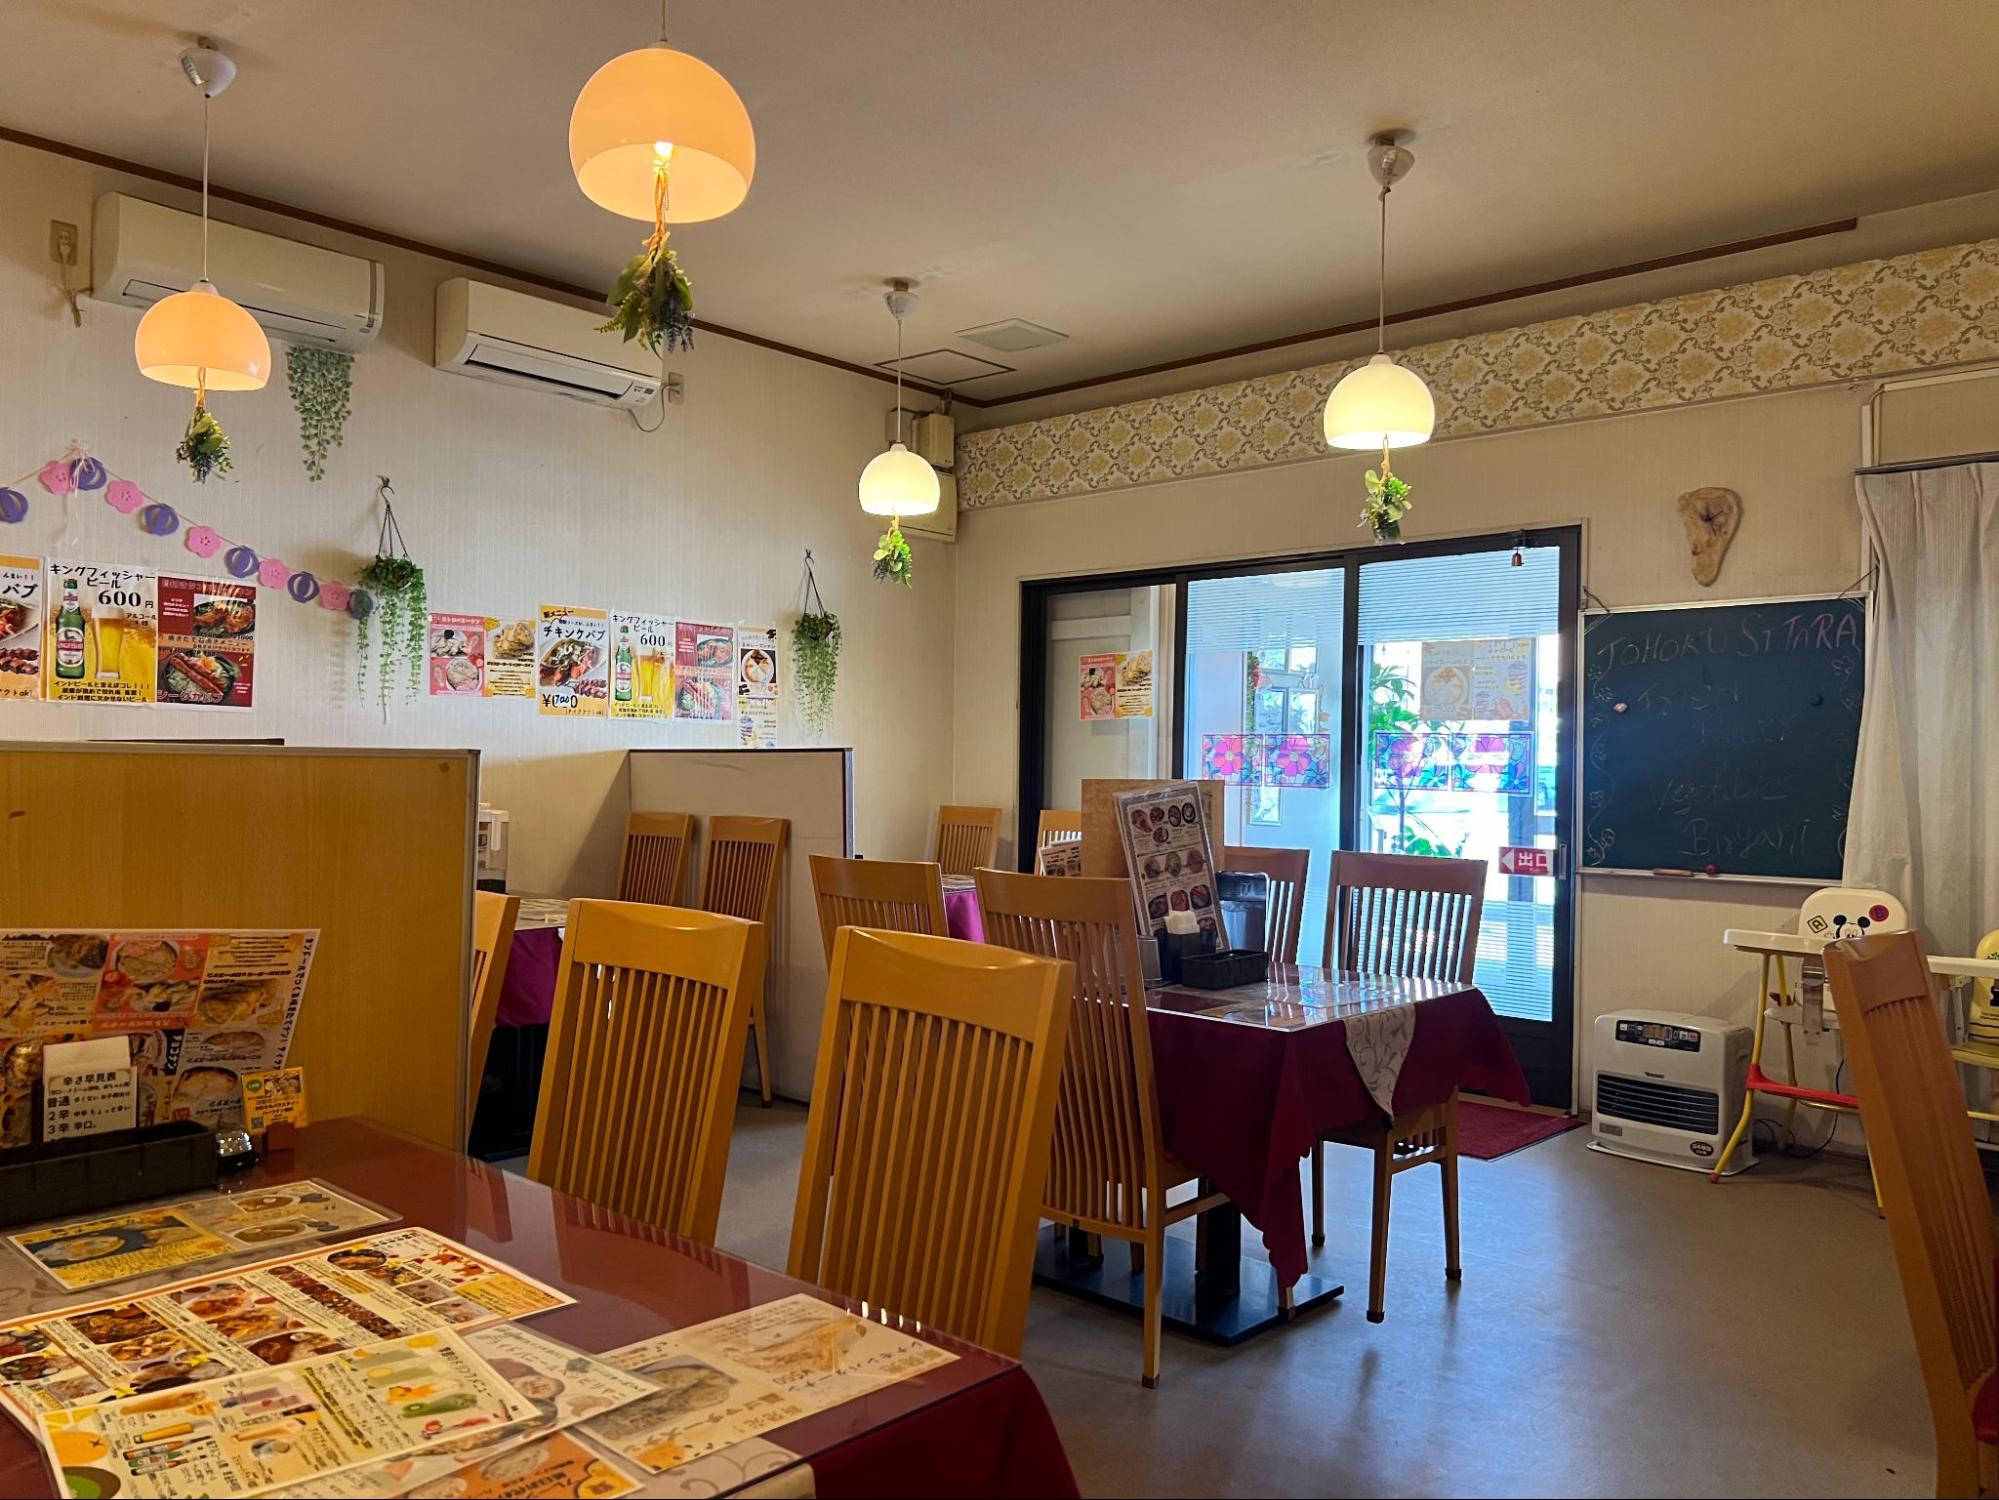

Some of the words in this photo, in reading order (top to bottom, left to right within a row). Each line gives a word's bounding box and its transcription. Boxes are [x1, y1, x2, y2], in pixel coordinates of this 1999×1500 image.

[50, 564, 156, 581] キングフィッシャー
[87, 577, 121, 588] ビール
[98, 590, 141, 607] 600
[612, 615, 674, 626] キングフィッシャー
[543, 626, 606, 640] チキンケバブ
[633, 624, 653, 633] ビール
[640, 634, 665, 647] 600
[1518, 852, 1547, 867] 出口
